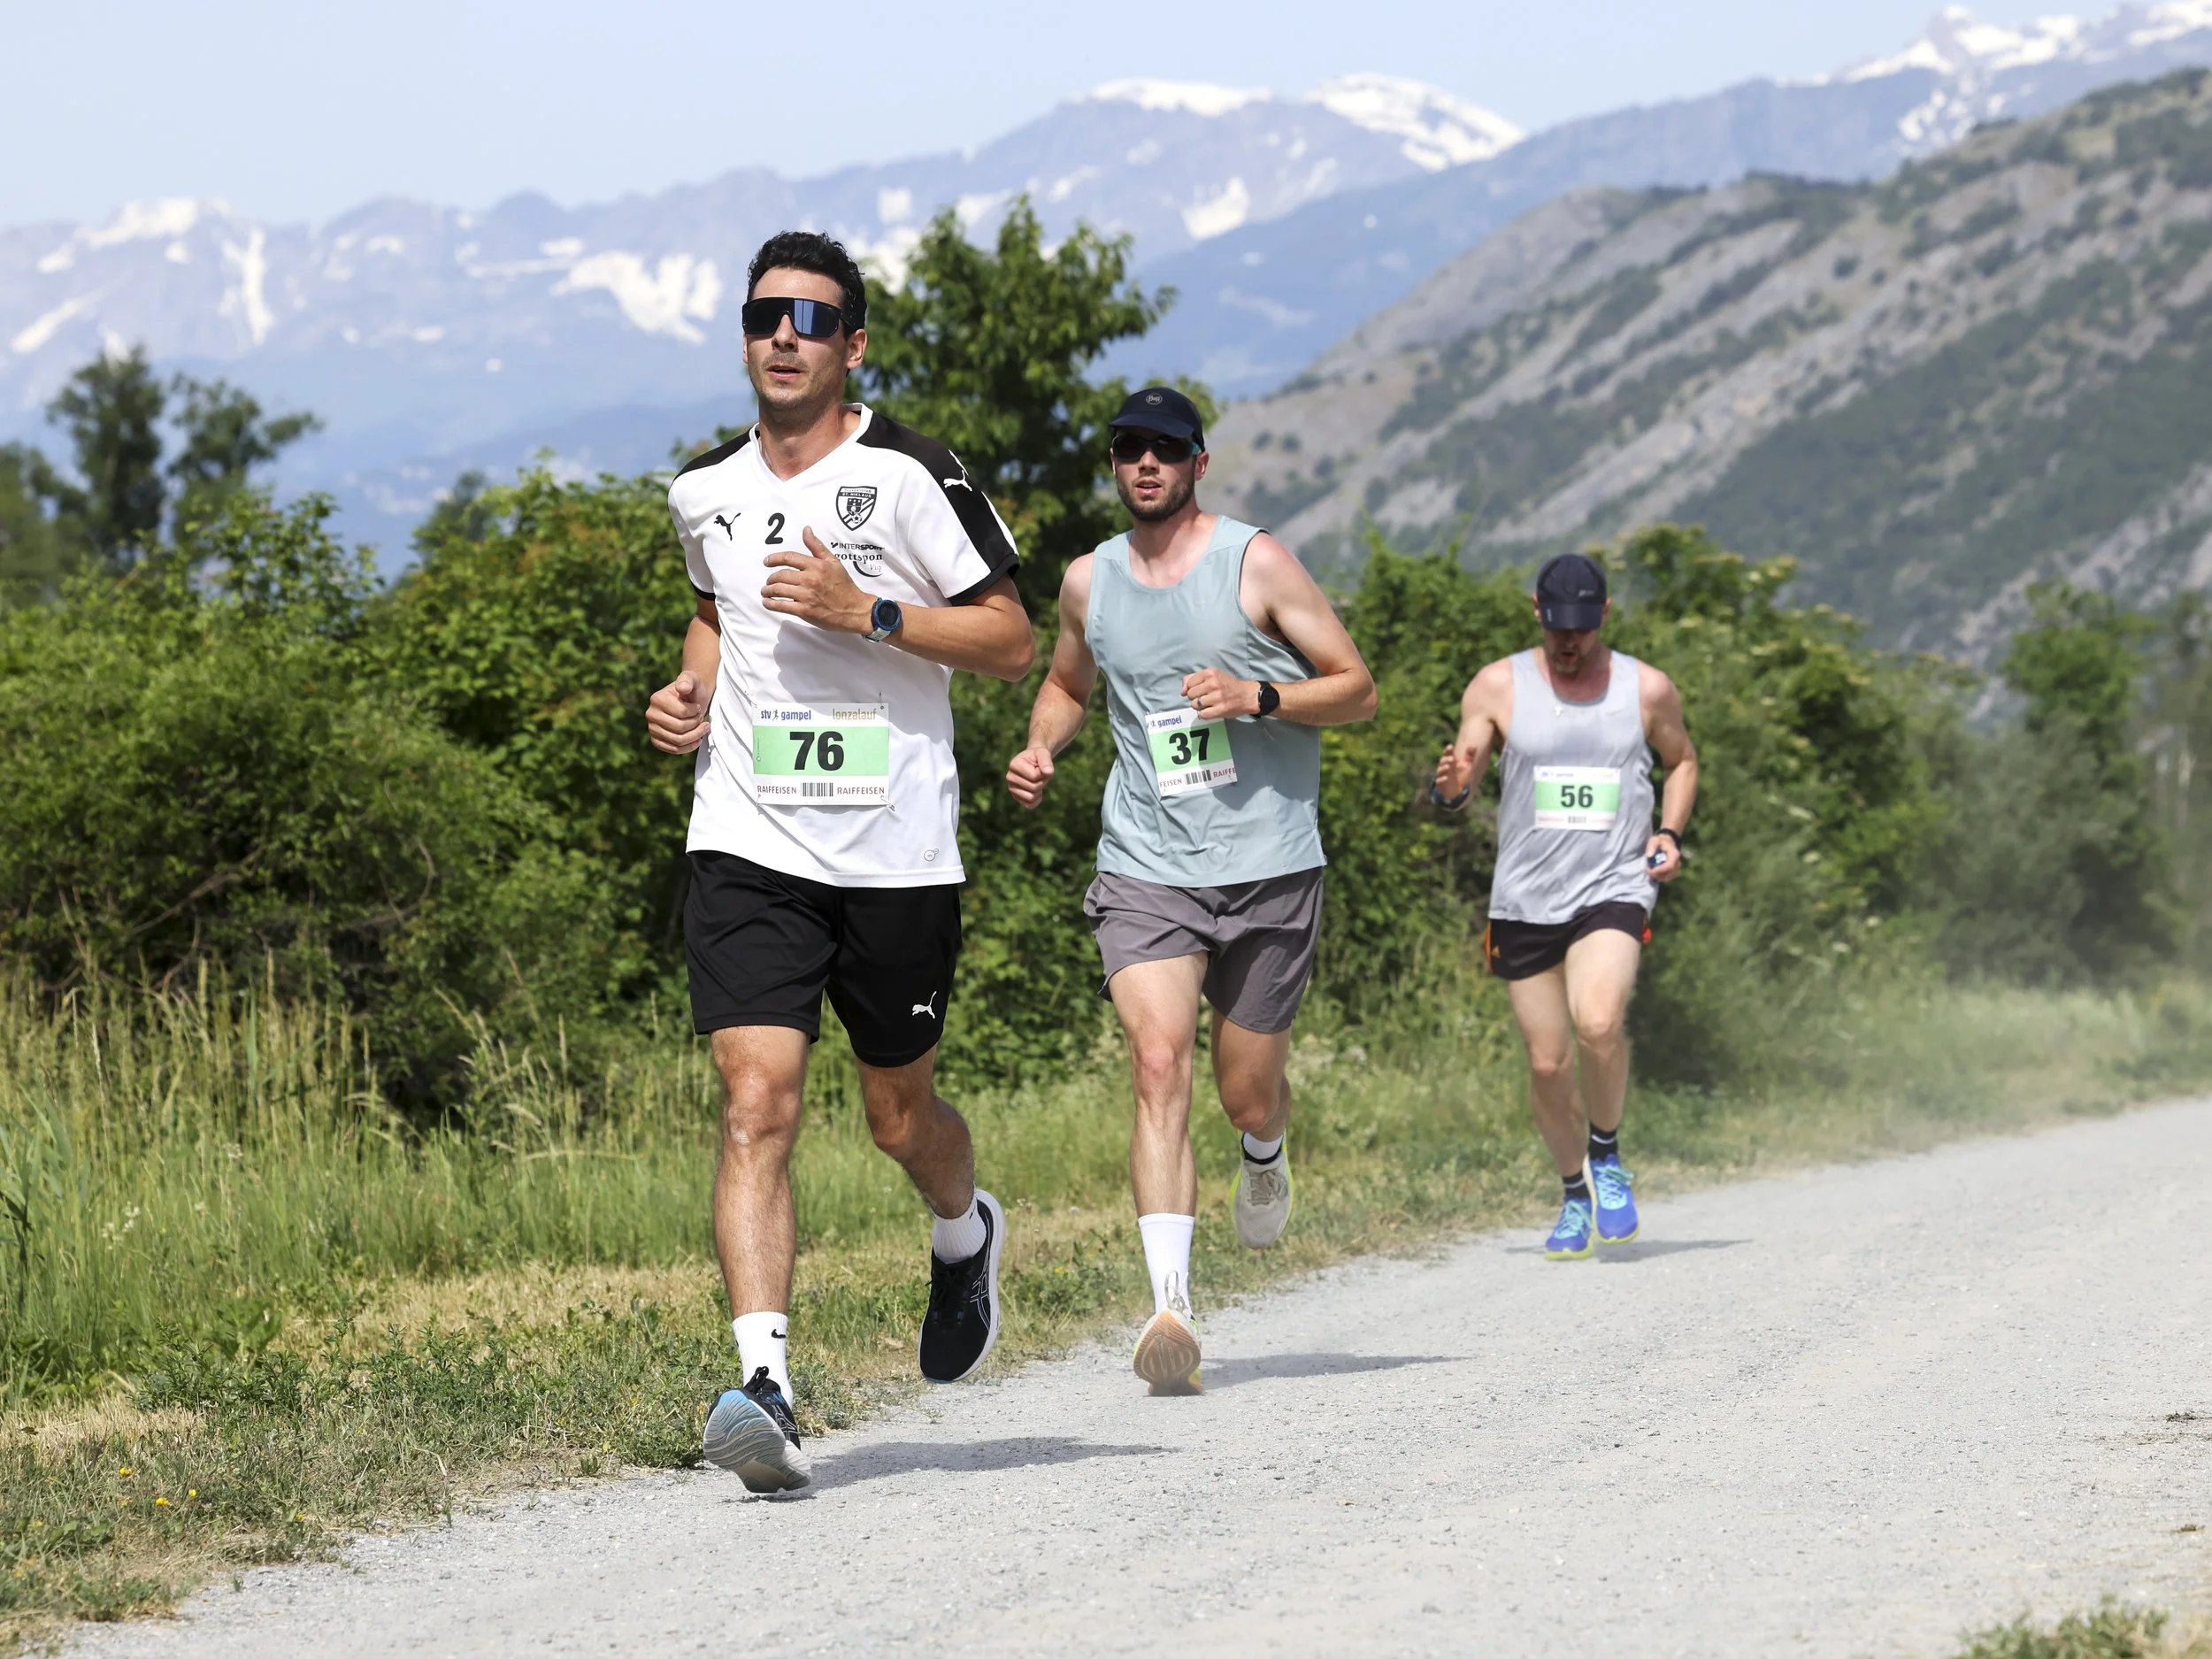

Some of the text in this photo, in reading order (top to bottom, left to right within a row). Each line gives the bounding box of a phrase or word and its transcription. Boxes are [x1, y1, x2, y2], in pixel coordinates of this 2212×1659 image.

[764, 512, 785, 544] 2
[761, 710, 811, 721] stv gampel
[833, 709, 877, 720] lonzalauf
[1157, 715, 1182, 727] gampel
[789, 731, 844, 771] 76
[1169, 728, 1210, 764] 37
[1159, 779, 1182, 788] FEISEN
[757, 785, 797, 795] RAIFFEISEN
[1560, 785, 1594, 808] 56
